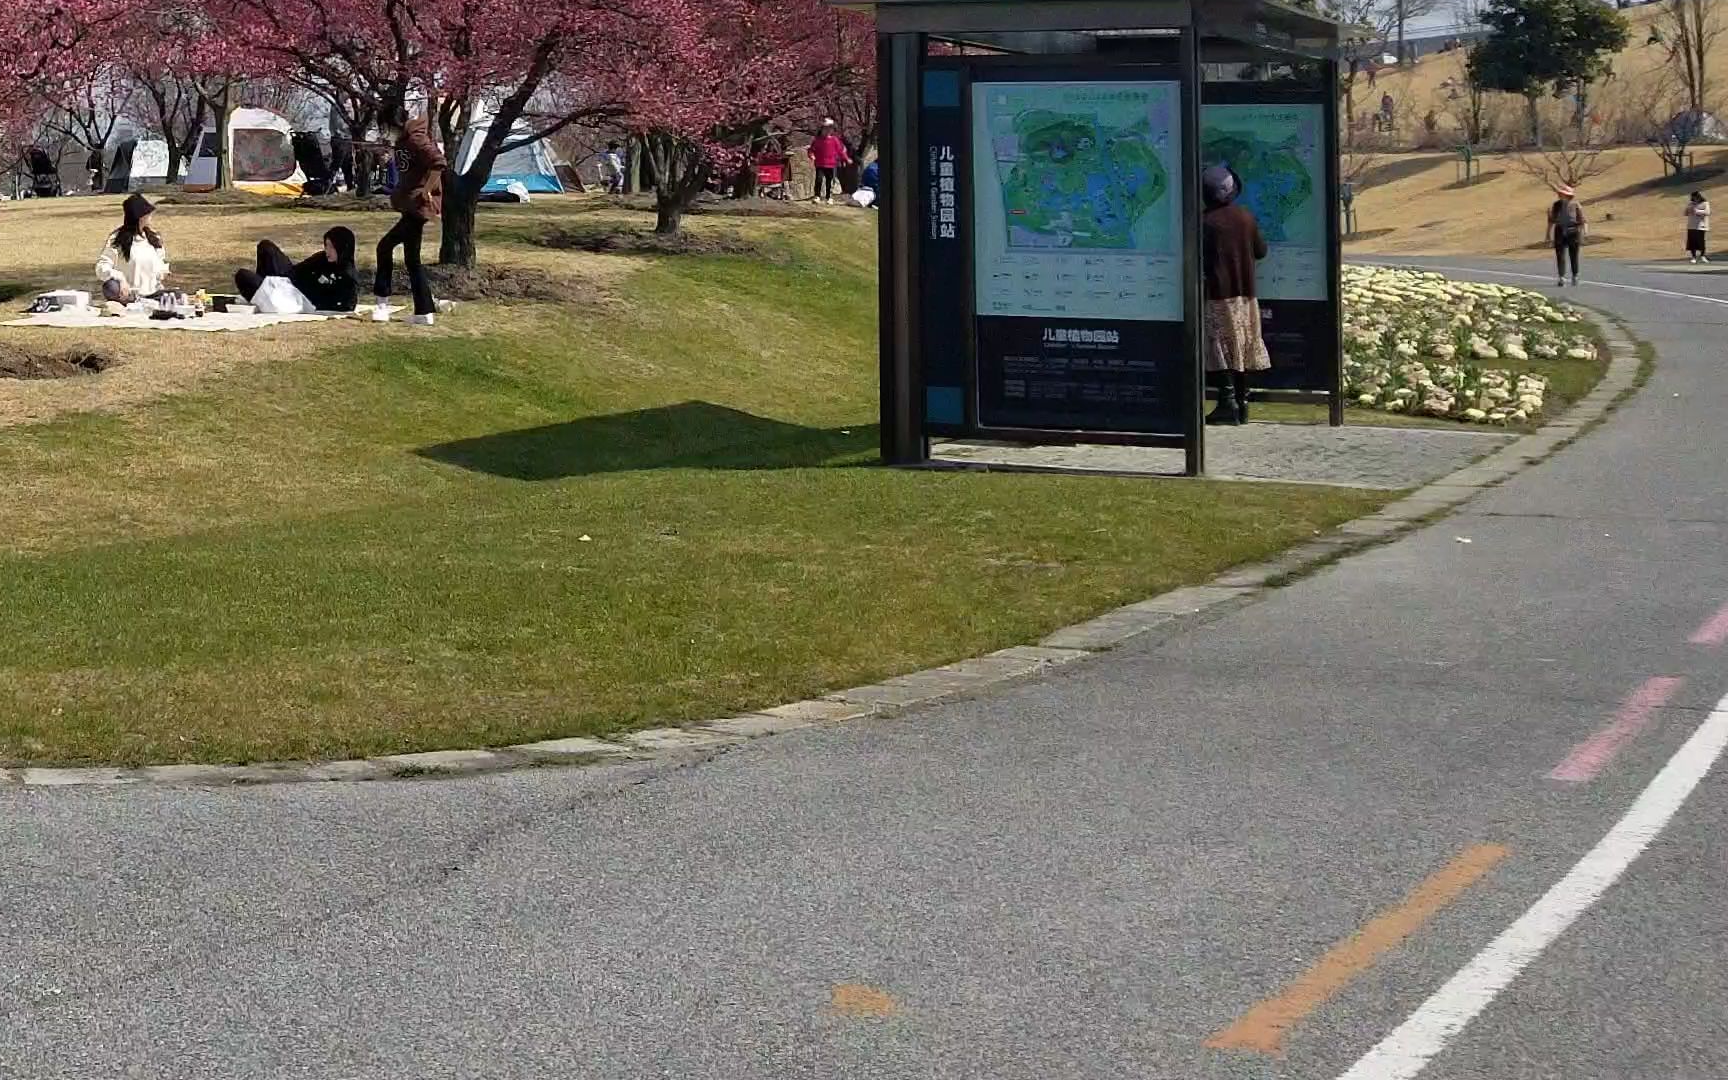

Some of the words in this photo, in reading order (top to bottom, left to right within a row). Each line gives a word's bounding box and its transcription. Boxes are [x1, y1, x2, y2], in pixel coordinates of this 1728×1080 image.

[939, 145, 955, 238] 儿童植物园站
[1042, 327, 1119, 343] 儿童植物园站
